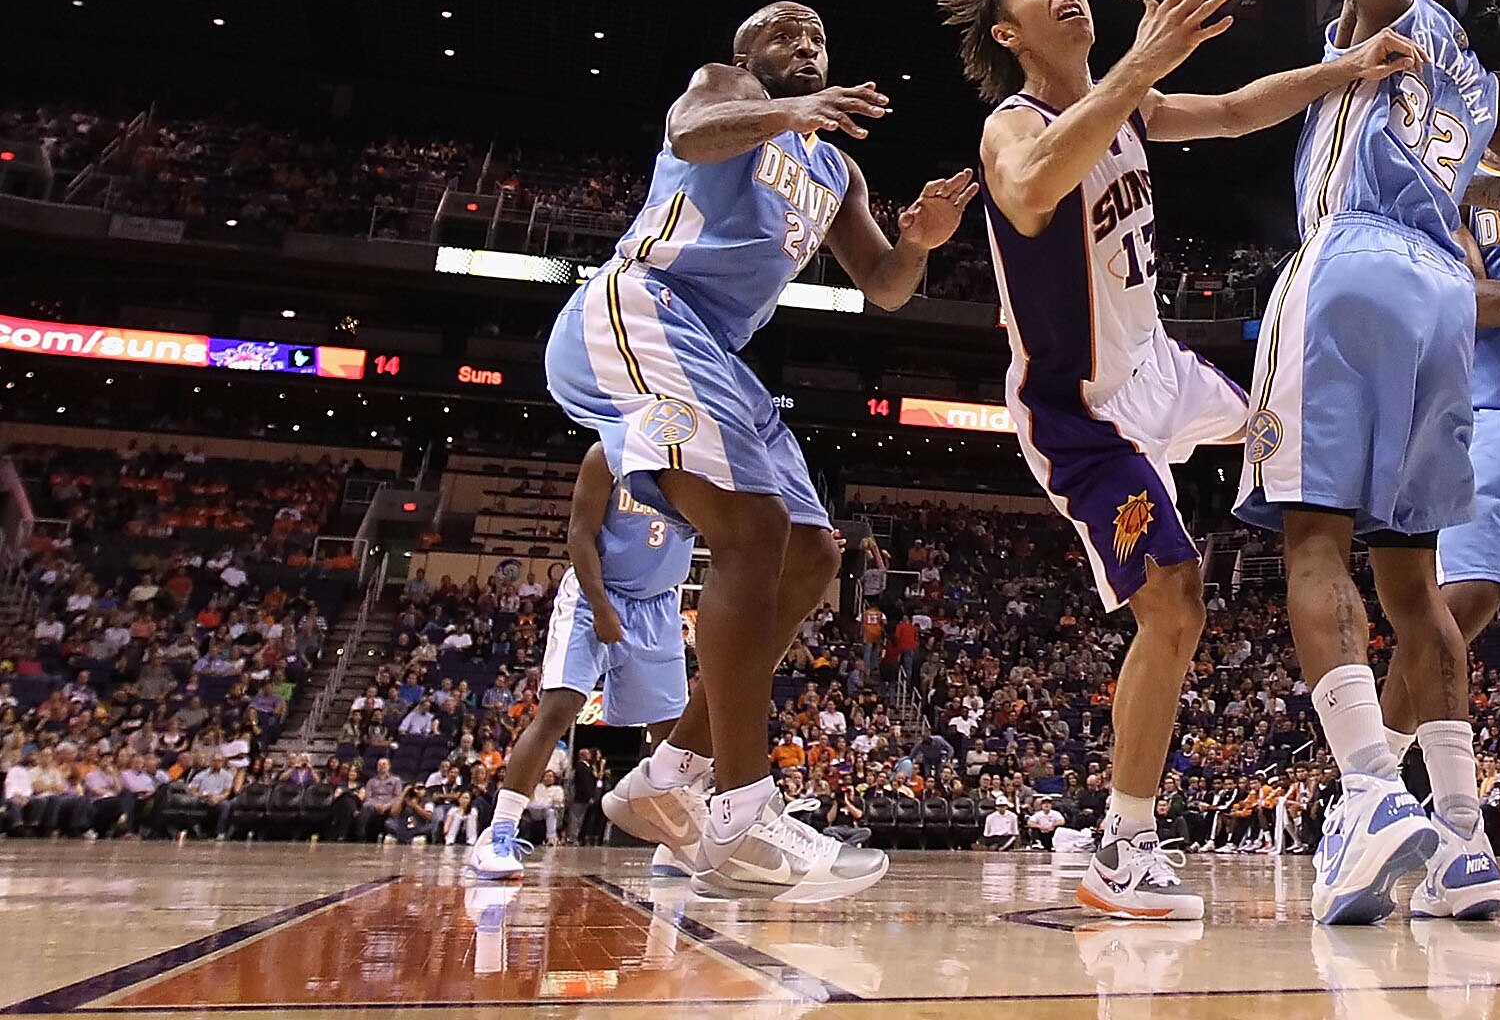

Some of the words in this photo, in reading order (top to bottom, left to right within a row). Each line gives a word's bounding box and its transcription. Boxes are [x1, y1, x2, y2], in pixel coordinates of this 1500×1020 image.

[754, 140, 842, 236] DENVE
[374, 356, 400, 375] 14
[457, 364, 502, 386] Suns
[867, 398, 890, 417] 14
[648, 519, 667, 549] 3
